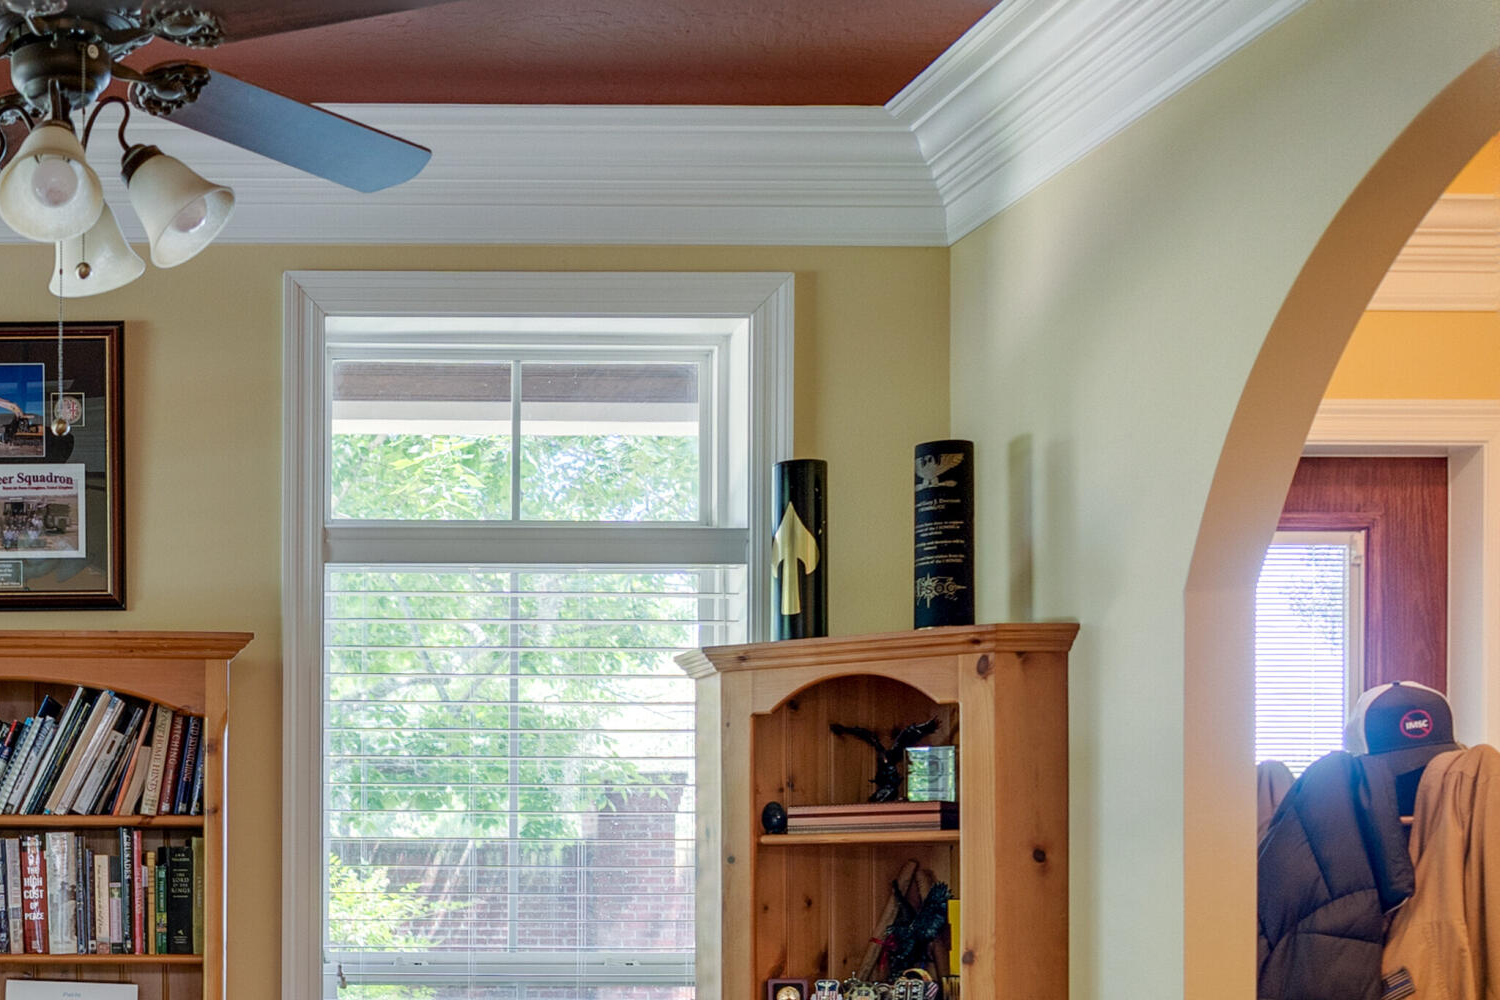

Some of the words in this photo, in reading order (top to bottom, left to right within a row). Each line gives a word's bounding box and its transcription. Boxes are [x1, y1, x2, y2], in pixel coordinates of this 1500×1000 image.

[17, 472, 74, 485] Squadron
[169, 717, 183, 765] WATCHING
[152, 734, 164, 763] HOME
[27, 866, 40, 874] THE
[23, 877, 43, 886] HIGH
[23, 889, 44, 900] COST
[25, 912, 44, 920] PEACE
